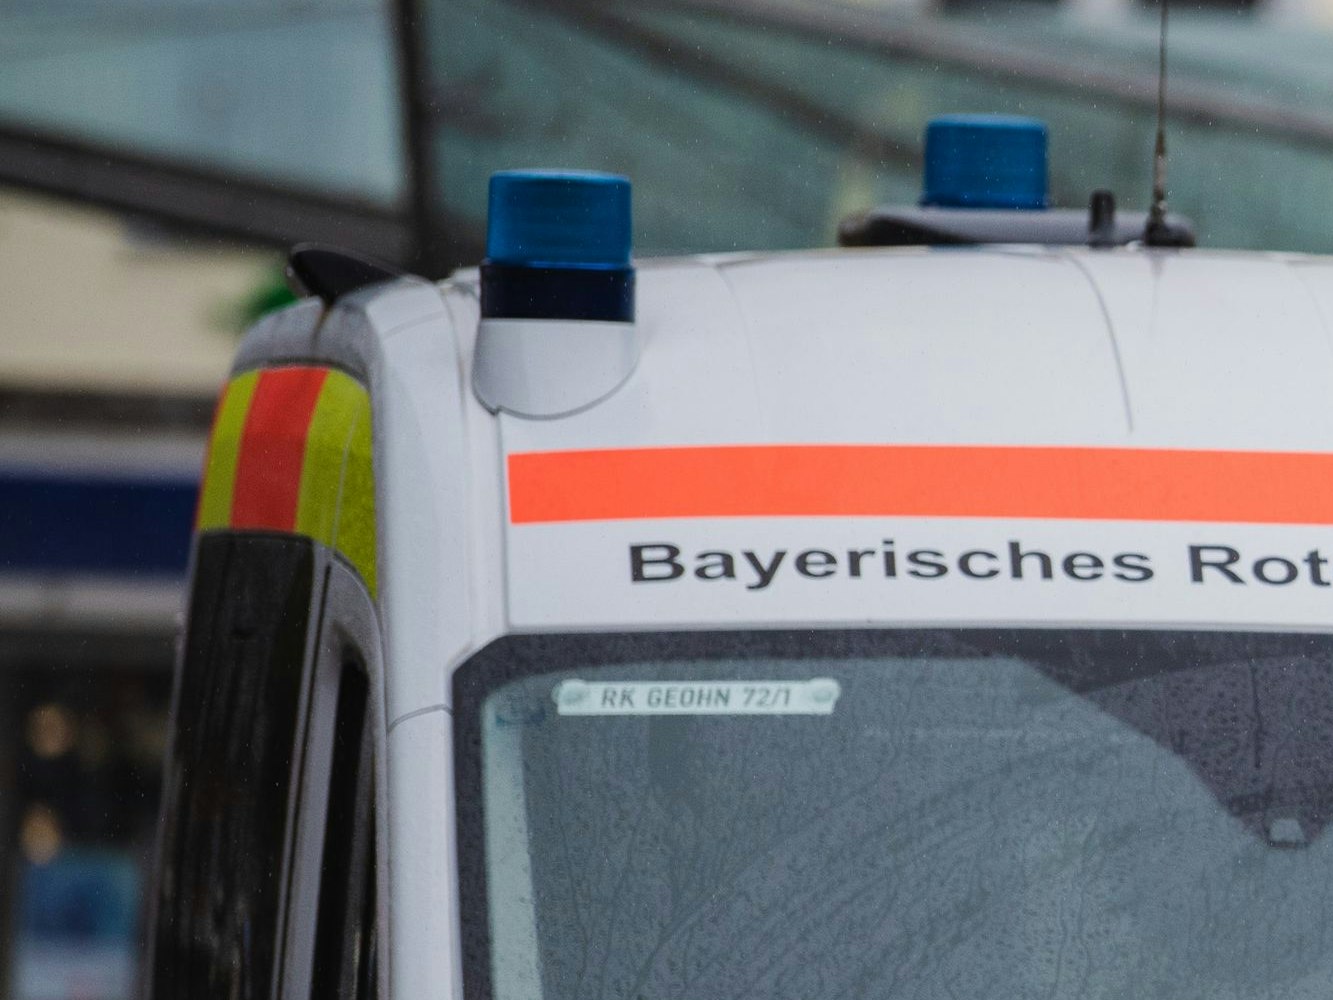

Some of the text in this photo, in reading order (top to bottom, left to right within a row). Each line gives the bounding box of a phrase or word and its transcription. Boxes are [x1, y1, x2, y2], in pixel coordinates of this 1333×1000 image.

[629, 541, 1154, 590] Bayerisches
[601, 688, 791, 708] RK GEOHN 72/1
